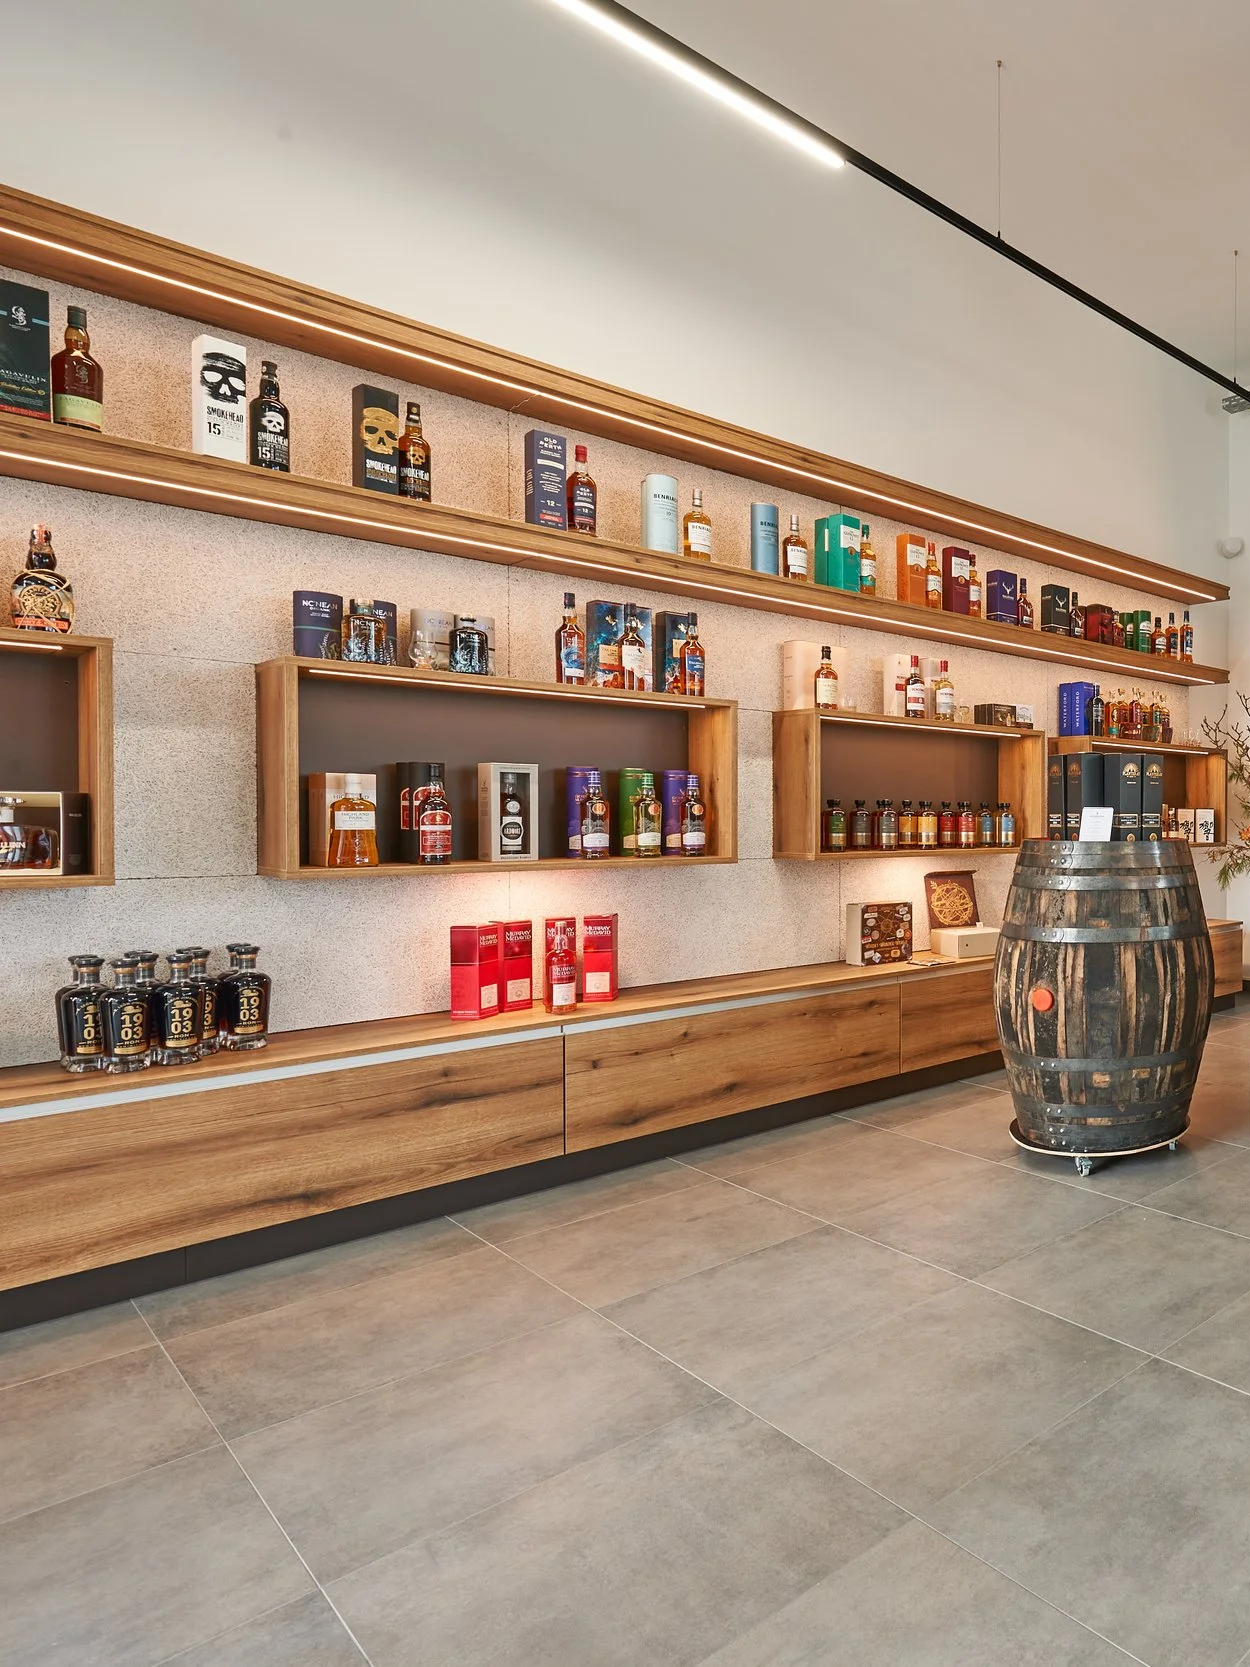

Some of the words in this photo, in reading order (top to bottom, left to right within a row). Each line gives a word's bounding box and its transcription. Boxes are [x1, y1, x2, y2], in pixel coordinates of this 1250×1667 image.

[206, 405, 244, 424] SMOKEHEAD
[206, 421, 221, 436] 15
[539, 440, 563, 450] PERTH
[543, 436, 558, 444] OLD
[257, 446, 272, 460] 15
[365, 458, 398, 475] SMOKEHEAD
[546, 499, 556, 507] 12
[505, 929, 532, 937] MURRAY
[239, 996, 260, 1010] 19
[120, 1012, 144, 1028] 19
[170, 1007, 193, 1022] 19
[239, 1008, 260, 1021] 03
[120, 1026, 143, 1041] 03
[170, 1020, 193, 1035] 03
